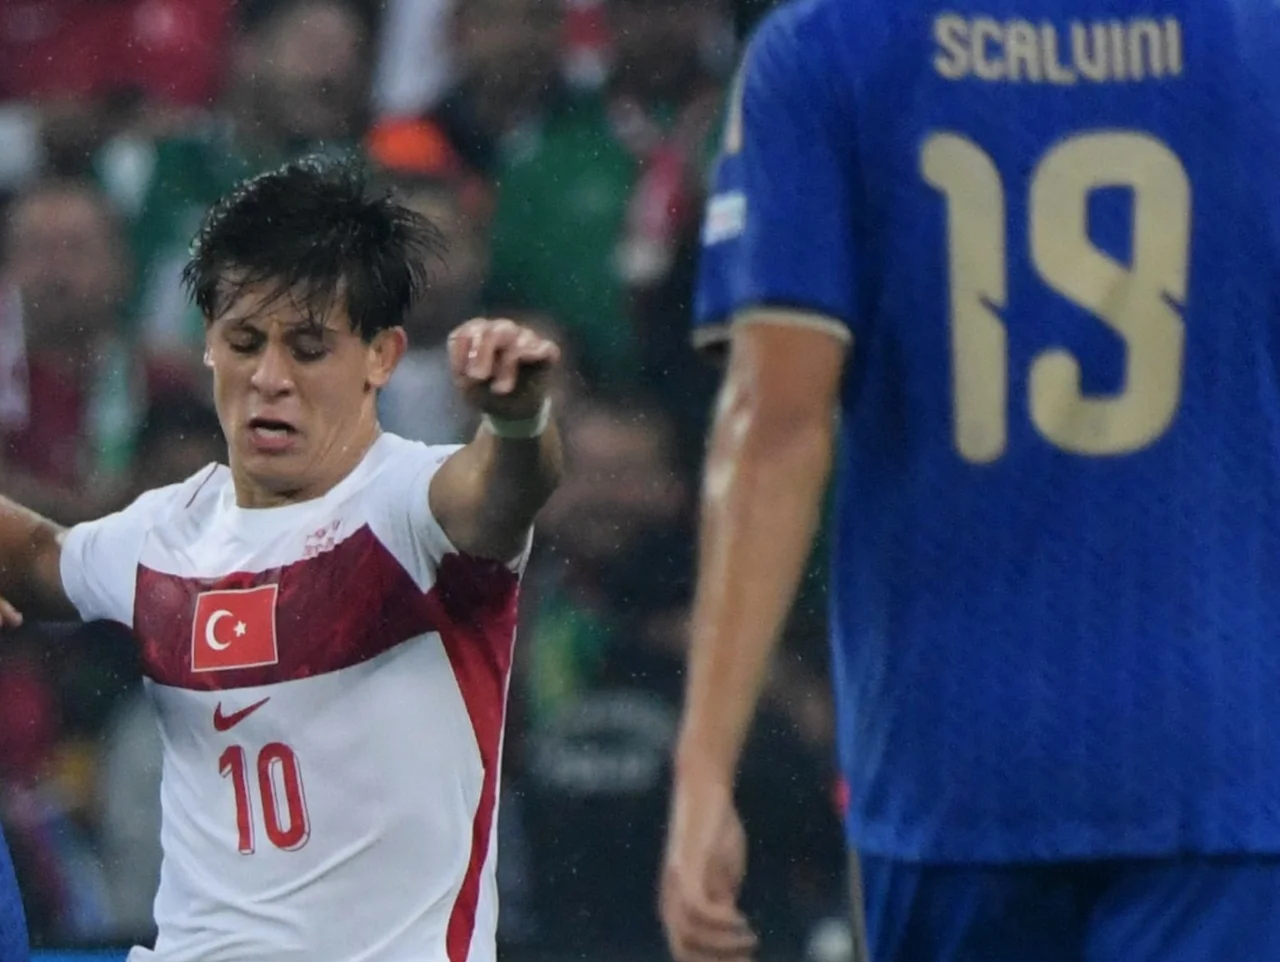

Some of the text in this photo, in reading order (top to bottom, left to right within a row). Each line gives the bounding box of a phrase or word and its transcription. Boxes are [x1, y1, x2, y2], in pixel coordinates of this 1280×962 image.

[933, 13, 1182, 85] SCALVINI
[920, 129, 1193, 465] 19
[218, 741, 312, 856] 10
